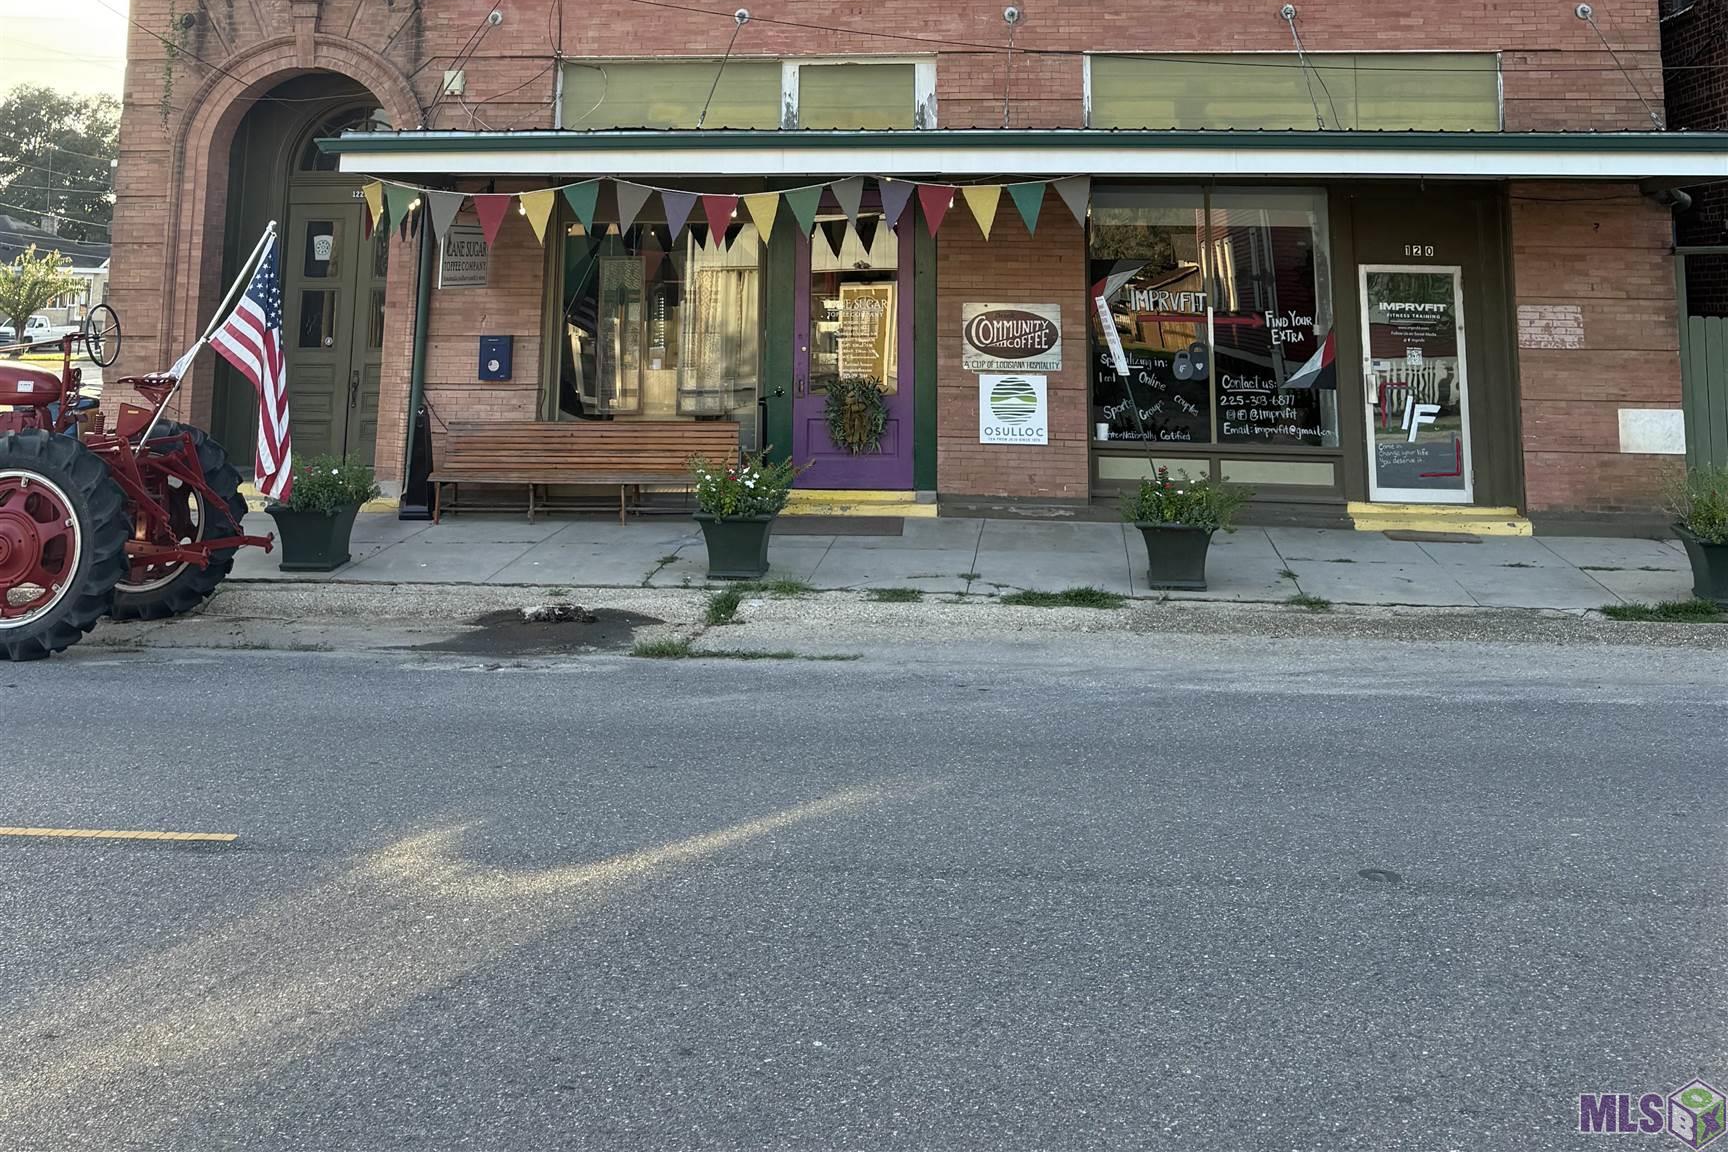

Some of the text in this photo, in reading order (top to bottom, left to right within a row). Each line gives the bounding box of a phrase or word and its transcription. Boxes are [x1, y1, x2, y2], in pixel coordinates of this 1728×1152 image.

[447, 234, 465, 257] CANE
[1405, 245, 1434, 256] 120
[462, 261, 486, 271] COMPANY
[1130, 289, 1207, 313] IMPRVFIT
[1379, 302, 1447, 312] IMPRVFIT
[971, 315, 1049, 347] COMMUNITY
[1007, 329, 1049, 349] COFFEE
[964, 360, 970, 368] A
[986, 360, 995, 368] OF
[1139, 372, 1167, 391] Online
[1222, 375, 1259, 389] Contact
[1103, 398, 1135, 420] Sports
[1401, 395, 1441, 442] IF
[984, 426, 1044, 437] OSULLOC
